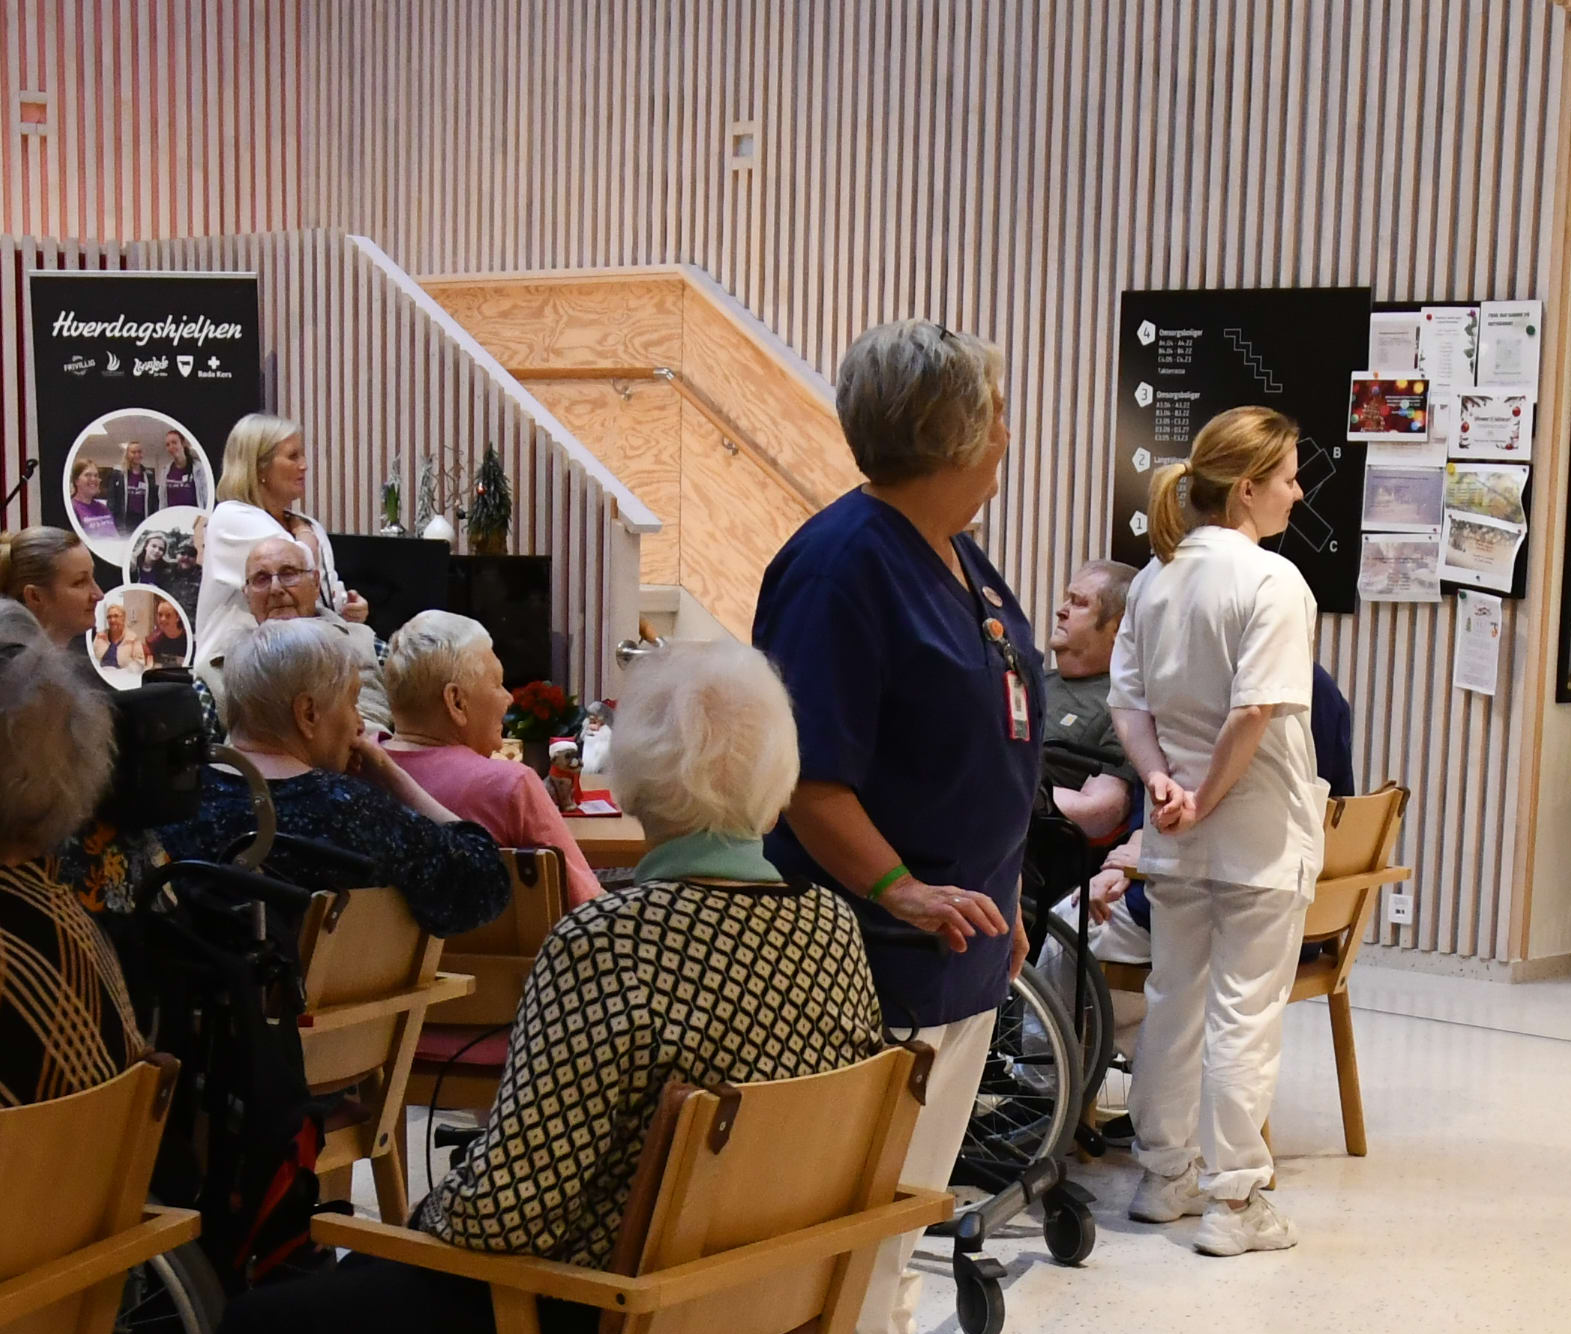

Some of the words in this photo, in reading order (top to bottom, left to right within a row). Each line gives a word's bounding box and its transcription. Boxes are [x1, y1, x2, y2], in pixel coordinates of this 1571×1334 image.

[52, 310, 242, 347] Hverdagshjelpen
[1143, 326, 1151, 339] 4
[1141, 388, 1148, 401] 3
[1333, 446, 1342, 459] B
[1138, 453, 1145, 466] 2
[1329, 540, 1338, 552] C
